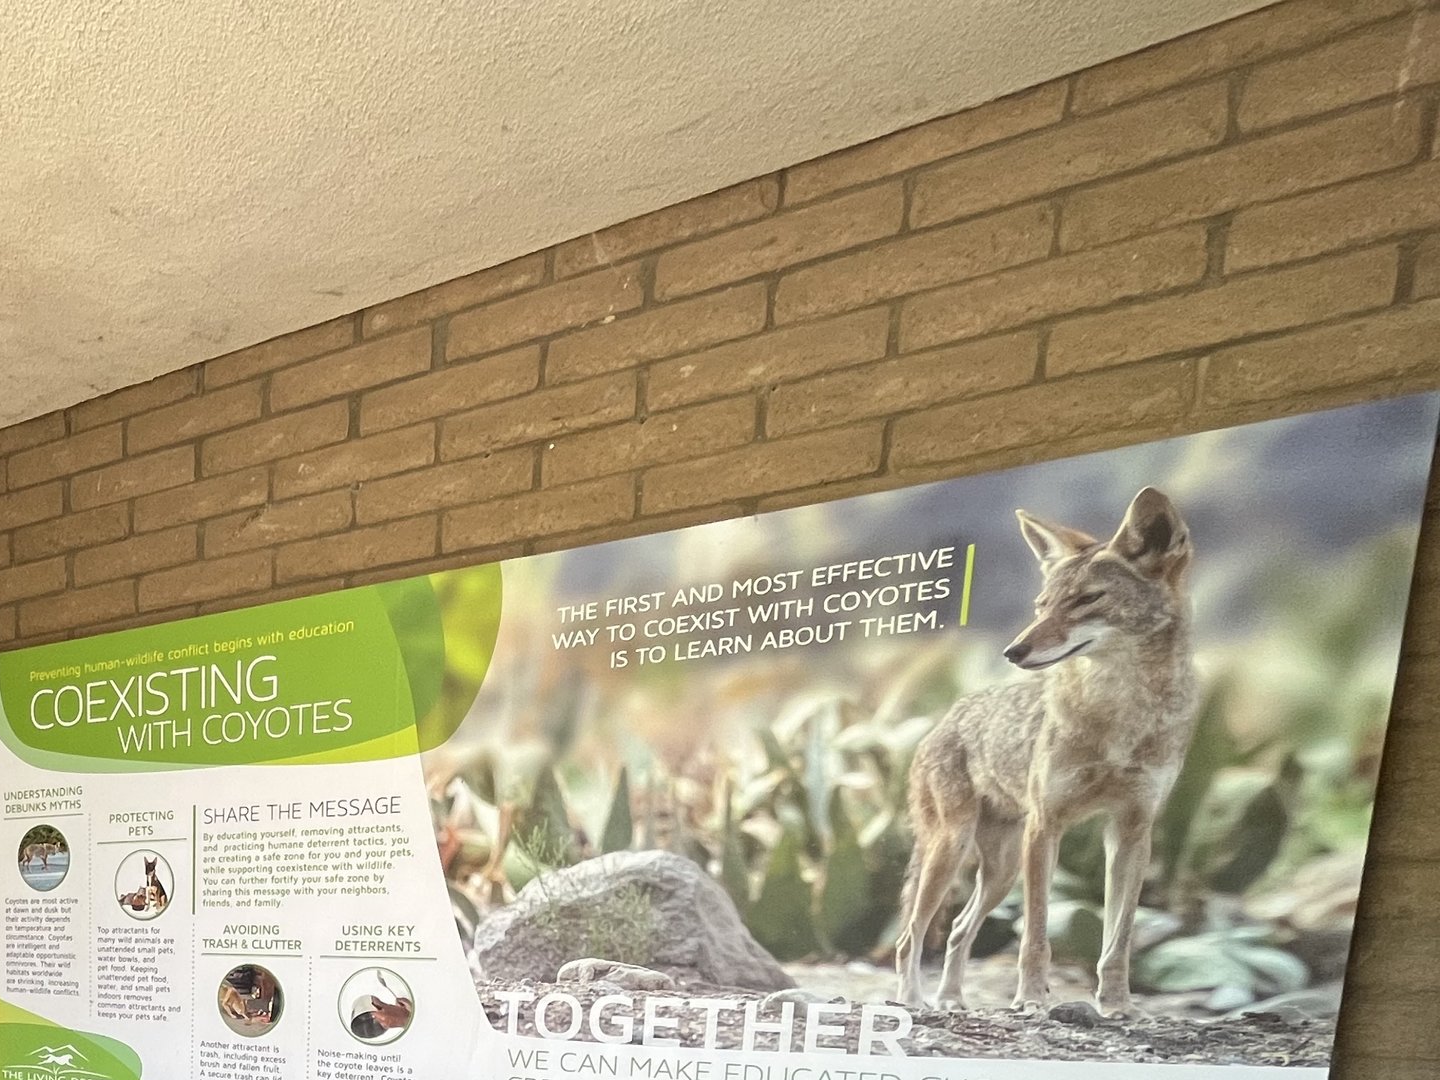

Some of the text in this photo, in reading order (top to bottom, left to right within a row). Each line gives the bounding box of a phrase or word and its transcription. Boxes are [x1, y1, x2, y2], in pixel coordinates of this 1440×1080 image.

[556, 546, 955, 623] THE FIRST AND MOST EFFECTIVE
[550, 577, 950, 650] WAY TO COEXIST WITH COYOTES
[609, 609, 944, 669] IS TO LEARN ABOUT THEM.
[29, 620, 354, 682] Preventing human-wildlife conflict begins with education
[29, 654, 278, 730] COEXISTING
[116, 698, 352, 754] WITH COYOTES
[2, 784, 83, 801] UNDERSTANDING
[4, 798, 82, 814] DEBUNKS MYTHS
[203, 795, 401, 825] SHARE THE MESSAGE
[108, 809, 174, 824] PROTECTING
[127, 824, 154, 836] PETS
[202, 832, 214, 843] By
[215, 831, 258, 841] educating
[300, 826, 345, 837] removing
[346, 823, 404, 835] attractants,
[202, 836, 410, 853] and practicing humane deterrent tactics, you
[202, 847, 414, 864] are creating a safe zone for you and your pets,
[202, 865, 225, 874] while
[227, 864, 273, 875] supporting
[275, 863, 329, 873] coexistence
[330, 861, 353, 871] with
[202, 872, 385, 886] You can further fortify your safe zone by
[201, 884, 390, 898] sharing this message with your neighbors,
[234, 898, 252, 907] and
[222, 923, 280, 936] AVOIDING
[341, 924, 415, 937] USING KEY
[201, 937, 302, 950] TRASH & CLUTTER
[334, 939, 421, 953] DETERRENTS
[492, 990, 917, 1062] TOGETHER
[199, 1039, 280, 1054] Another attractant is
[316, 1048, 401, 1063] Noise-making until
[506, 1048, 549, 1071] WE
[559, 1051, 618, 1076] CAN
[1, 1068, 23, 1080] THE
[316, 1059, 413, 1075] the coyote leaves is a
[316, 1068, 332, 1080] key
